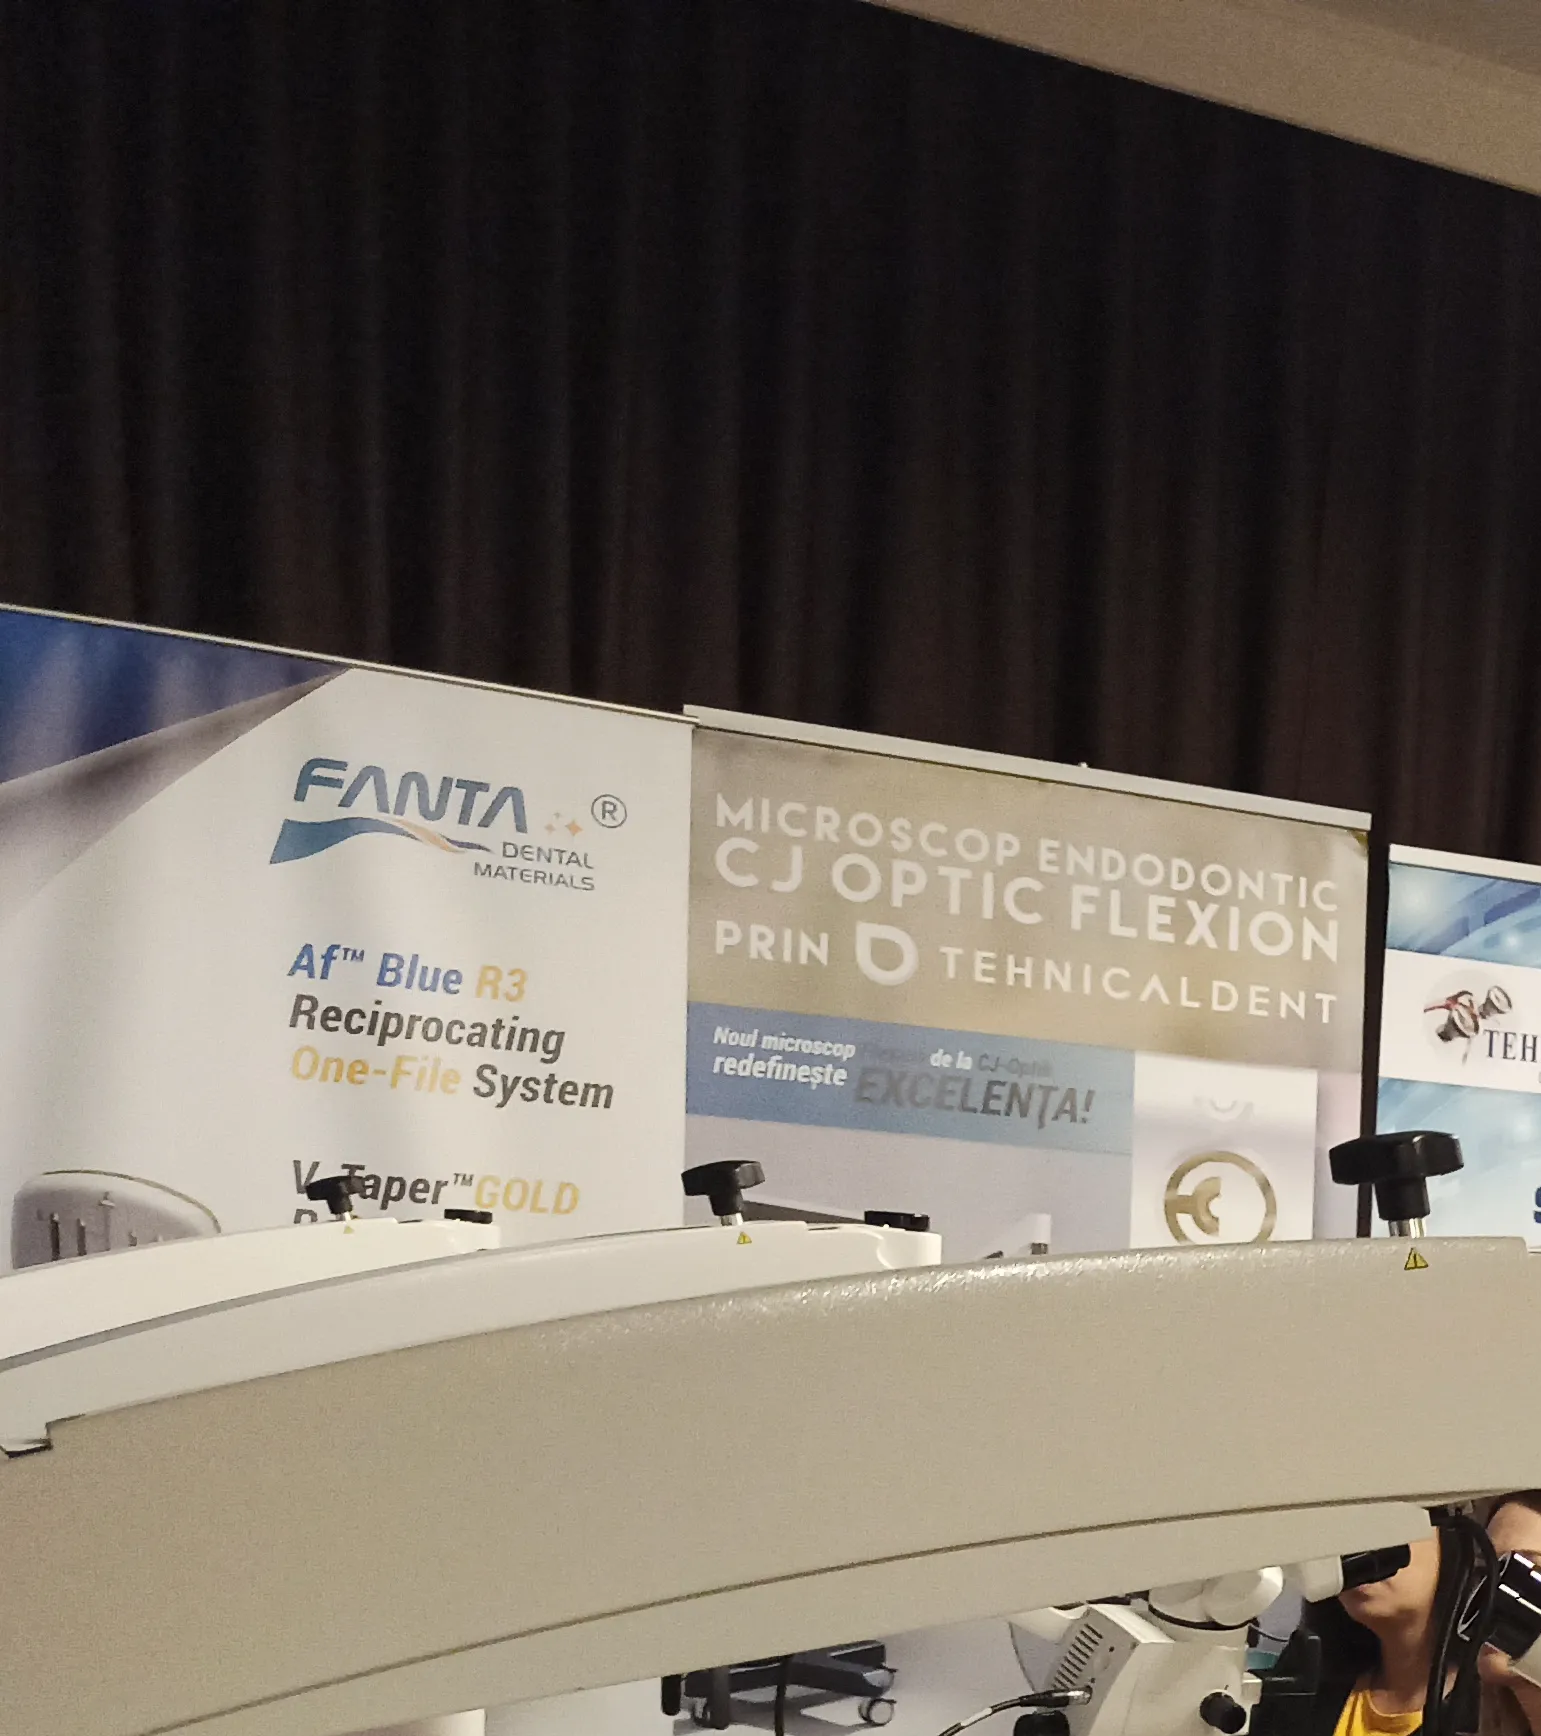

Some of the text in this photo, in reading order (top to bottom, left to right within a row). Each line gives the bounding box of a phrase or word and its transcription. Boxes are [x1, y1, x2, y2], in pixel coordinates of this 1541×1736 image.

[292, 756, 529, 834] FANTA
[473, 861, 596, 892] MATERIALS
[501, 840, 595, 870] DENTAL
[715, 793, 1339, 912] MICROSCOP ENDODONTIC
[715, 837, 1339, 963] CJ OPTIC FLEXION
[376, 951, 463, 996] Blue
[474, 964, 529, 1003] R3
[715, 919, 1338, 1024] PRIN TEHNICALDENT
[288, 994, 565, 1064] Reciprocating
[712, 1025, 759, 1048] Noul
[760, 1031, 857, 1062] microscop
[929, 1047, 953, 1069] de
[955, 1049, 974, 1071] la
[290, 1046, 615, 1110] One-File System
